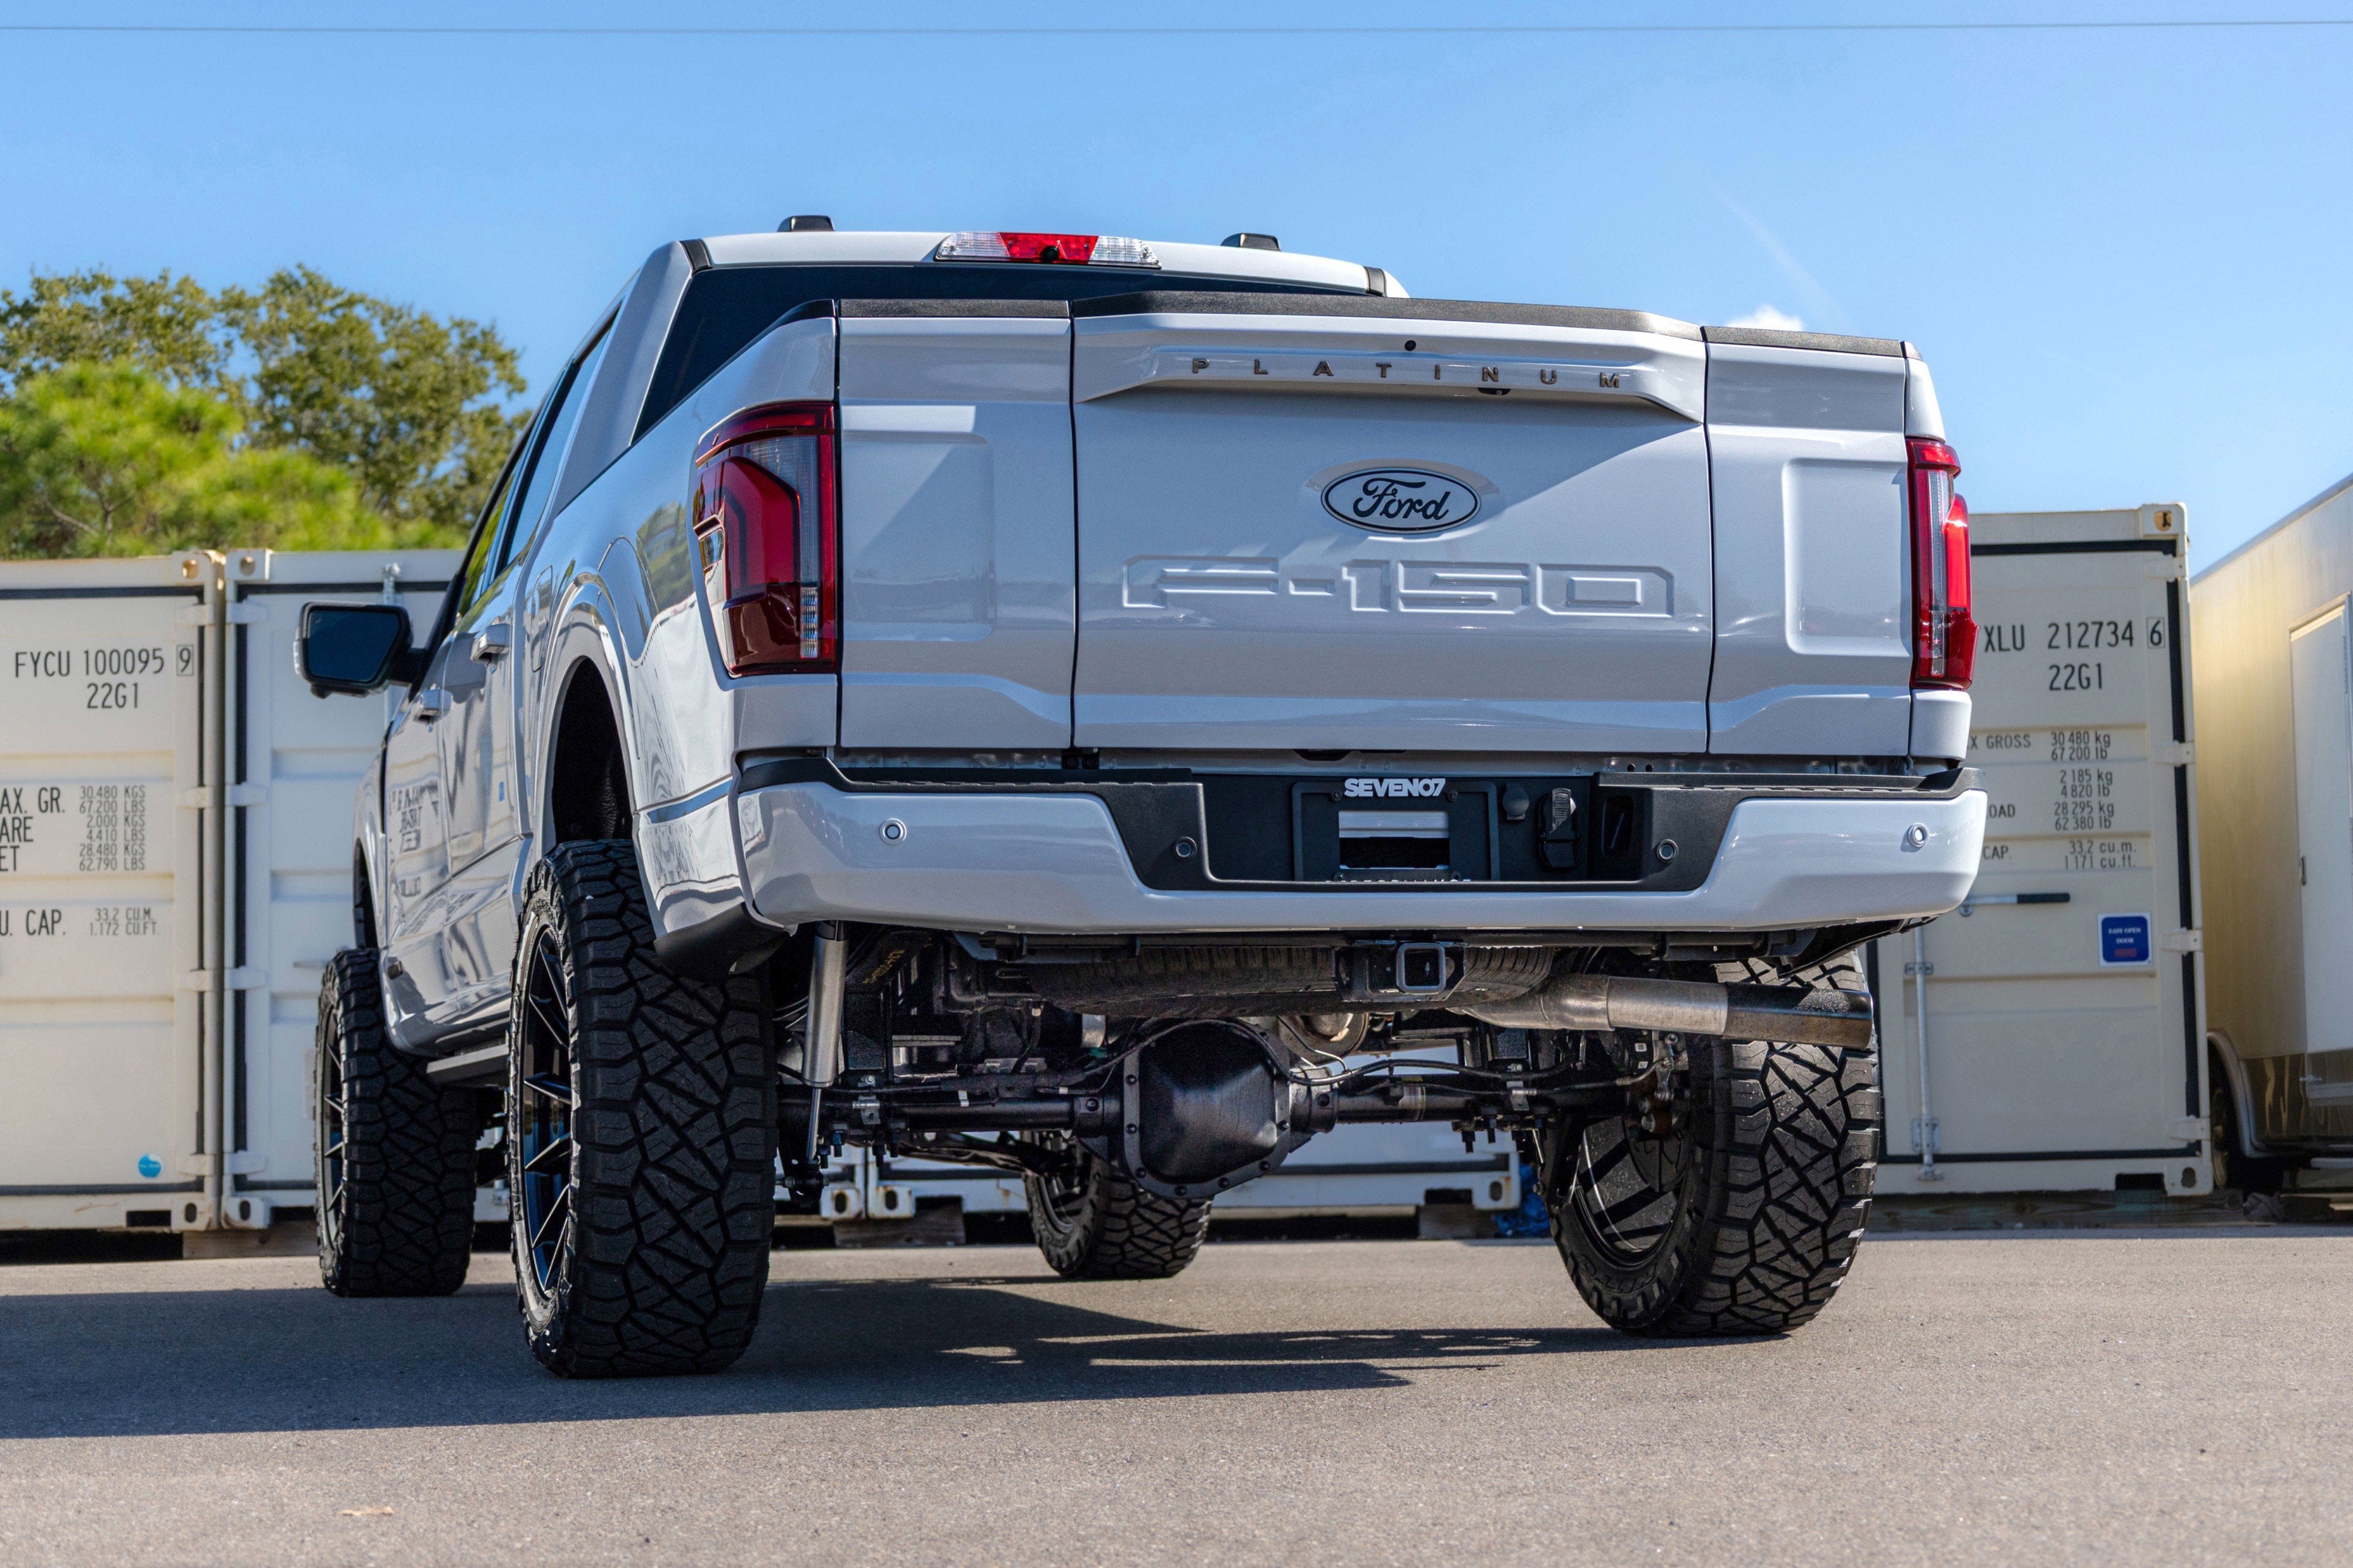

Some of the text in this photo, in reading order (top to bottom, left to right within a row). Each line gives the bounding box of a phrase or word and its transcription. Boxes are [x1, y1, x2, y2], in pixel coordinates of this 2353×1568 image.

[1192, 358, 1620, 388] PLATINUM
[1353, 478, 1451, 520] Ford
[1122, 555, 1674, 617] F-150
[1984, 620, 2163, 652] XLU 212734 6
[15, 648, 191, 677] FYCU 100095 9
[2049, 663, 2103, 691] 22G1
[87, 682, 138, 709] 22G1
[1986, 733, 2031, 749] GROSS
[2095, 730, 2111, 748] kg
[2096, 746, 2107, 759] lb
[2097, 768, 2113, 786] kg
[80, 785, 145, 799] 30.480 KGS
[2098, 784, 2110, 796] lb
[38, 787, 65, 813] GR.
[124, 800, 145, 813] LBS
[1987, 804, 2016, 819] OAD
[2098, 801, 2114, 818] kg
[124, 814, 145, 827] KGS
[2099, 816, 2112, 829] lb
[124, 829, 145, 842] LBS
[124, 843, 145, 856] KGS
[124, 857, 145, 871] LBS
[26, 909, 65, 936] CAP.
